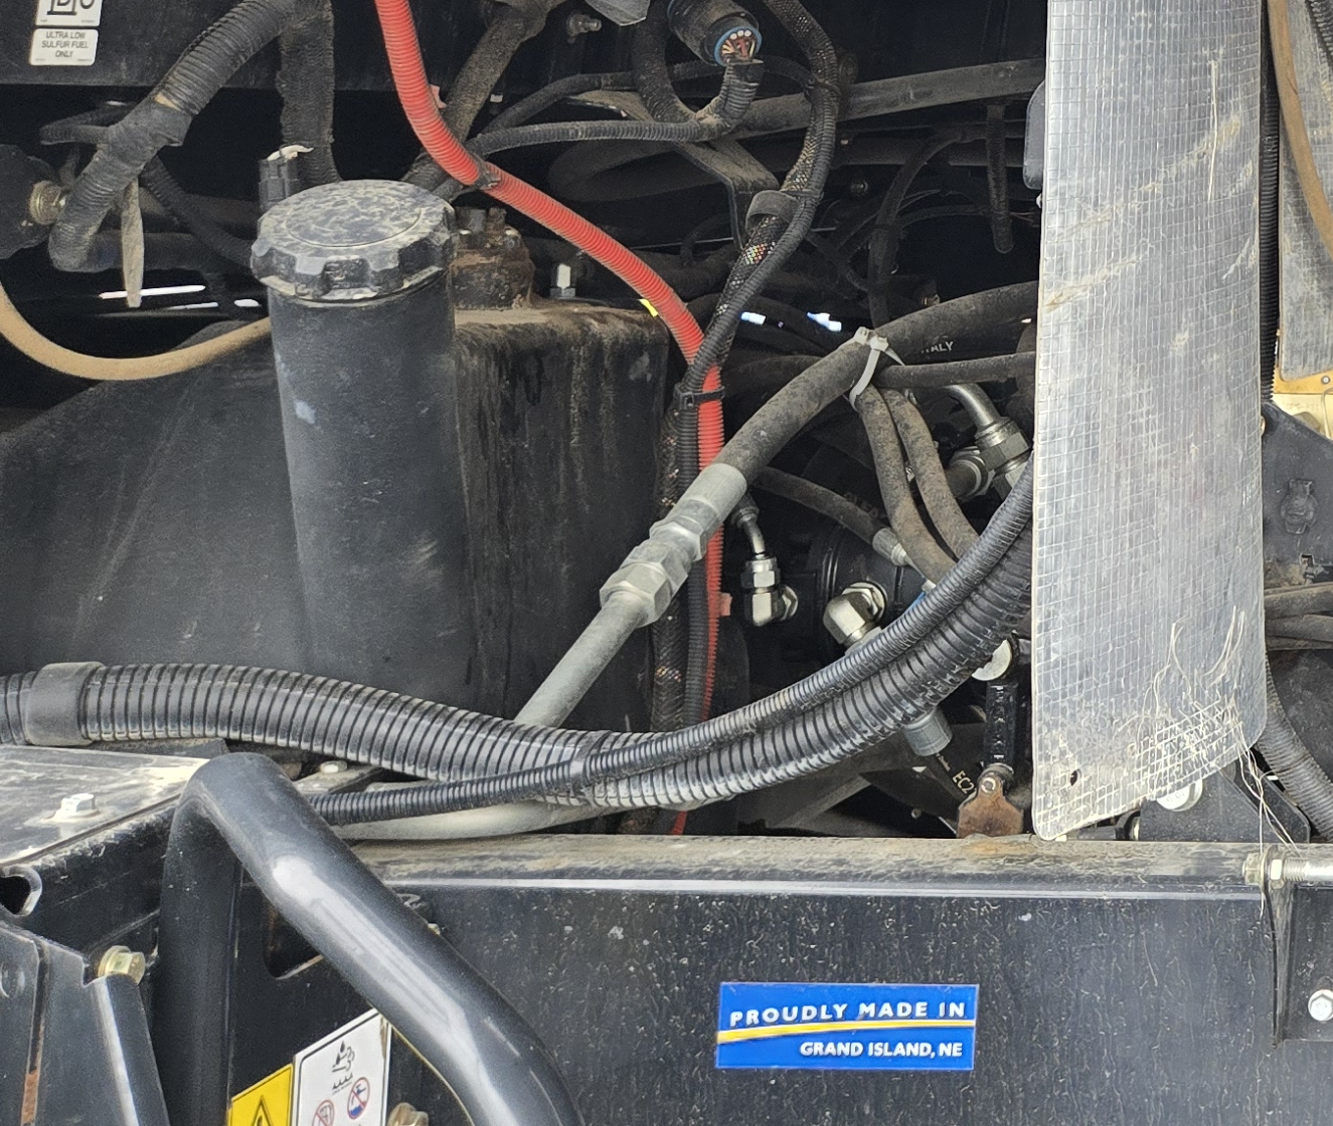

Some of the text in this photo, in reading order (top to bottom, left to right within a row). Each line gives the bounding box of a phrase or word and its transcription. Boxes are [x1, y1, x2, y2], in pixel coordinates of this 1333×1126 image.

[46, 31, 86, 39] ULTRA LOW
[41, 40, 89, 48] SULFUR FUEL
[55, 49, 74, 58] ONLY
[729, 1001, 965, 1027] PROUDLY MADE IN
[799, 1041, 963, 1059] GRAND ISLAND, NE
